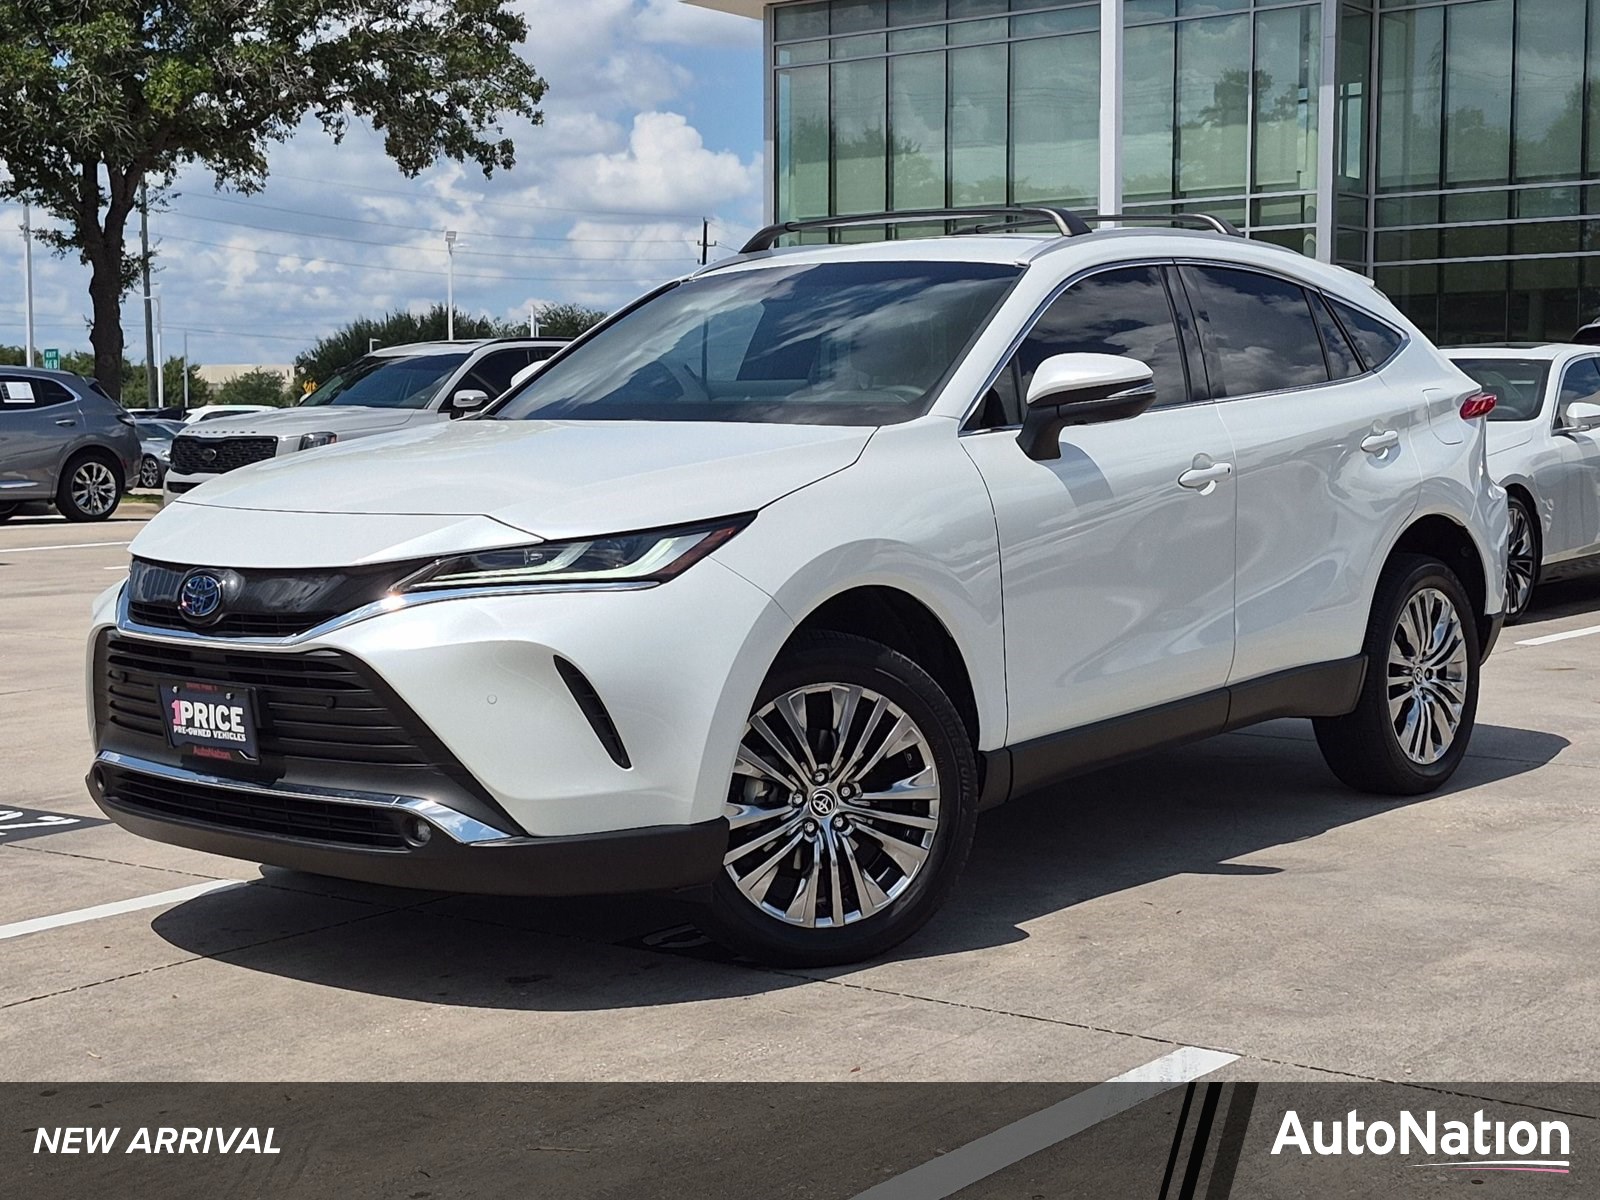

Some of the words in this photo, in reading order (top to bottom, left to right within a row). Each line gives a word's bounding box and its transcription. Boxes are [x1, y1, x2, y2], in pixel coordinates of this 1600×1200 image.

[171, 699, 245, 733] 1PRICE
[173, 725, 212, 737] PRE-OWNED
[212, 730, 247, 742] VEHICLES
